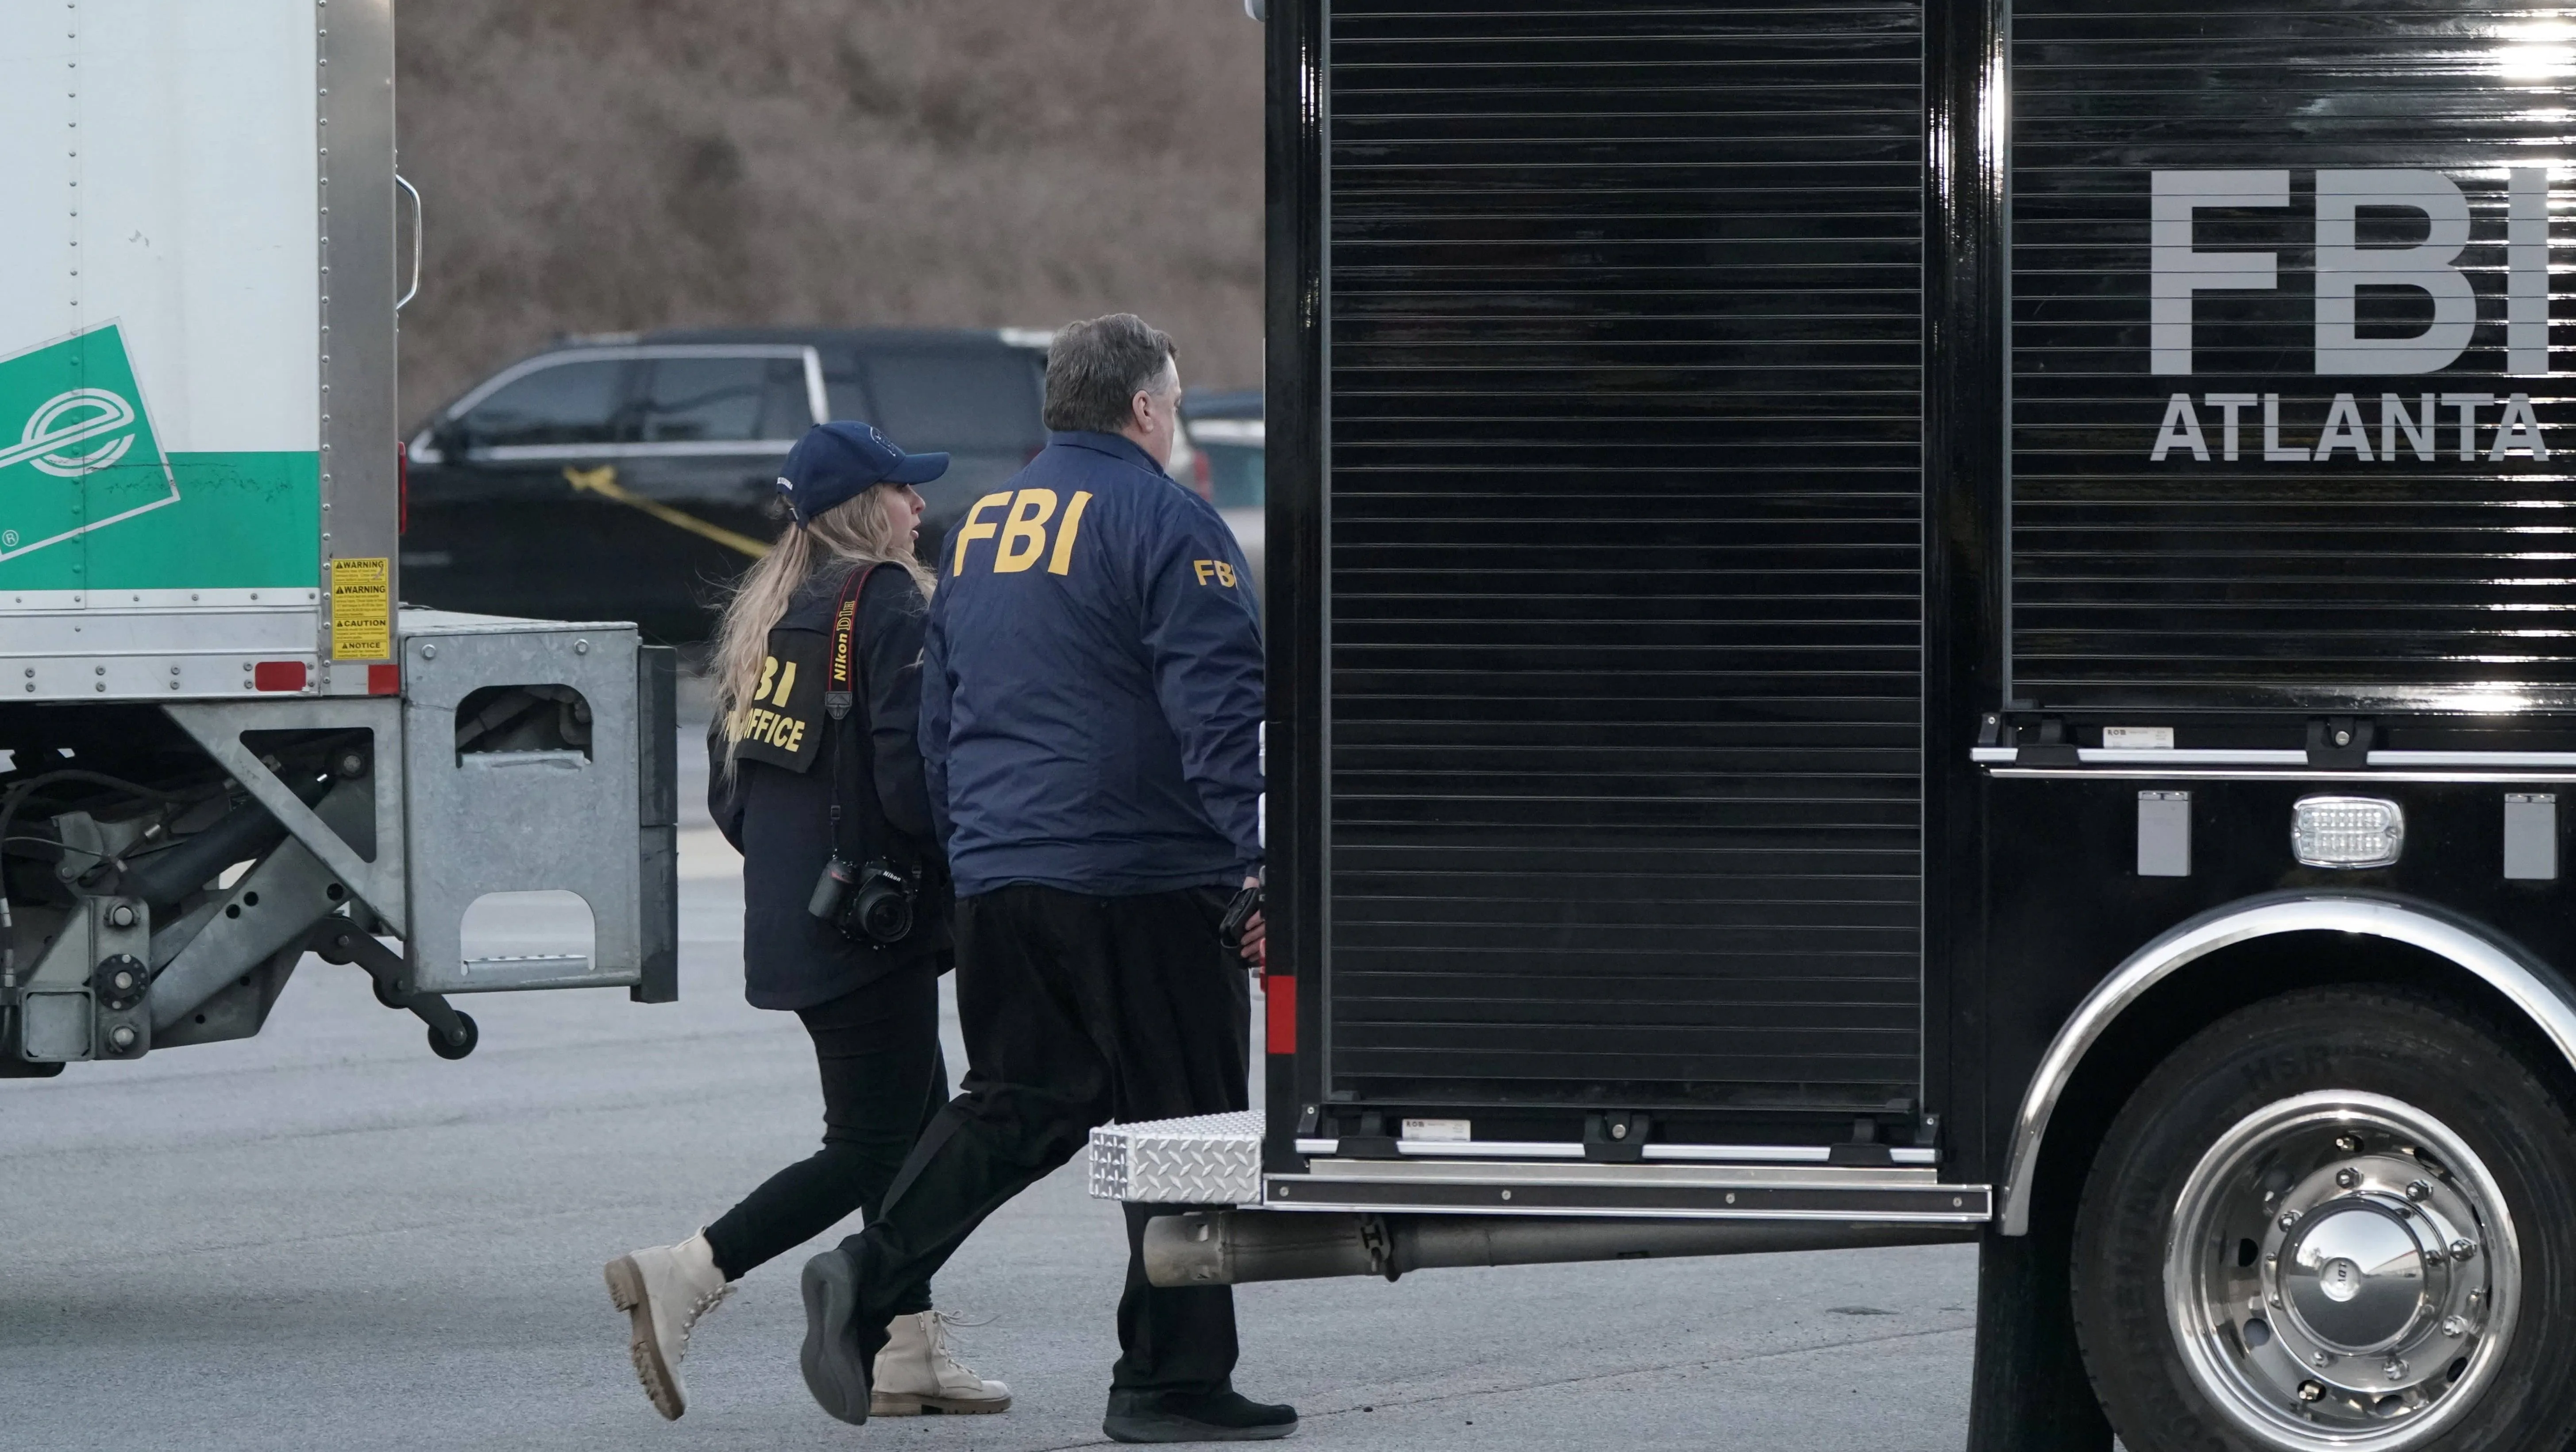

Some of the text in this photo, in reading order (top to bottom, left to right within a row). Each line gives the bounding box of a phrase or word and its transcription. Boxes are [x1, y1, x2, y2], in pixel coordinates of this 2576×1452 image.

[2151, 169, 2549, 375] FBI
[2150, 393, 2550, 461] ATLANTA
[953, 488, 1093, 577] FBI
[344, 585, 386, 594] WARNING
[754, 656, 797, 708] BI
[834, 633, 848, 682] Nikon
[744, 708, 806, 753] FFICE
[883, 870, 902, 882] Nikon
